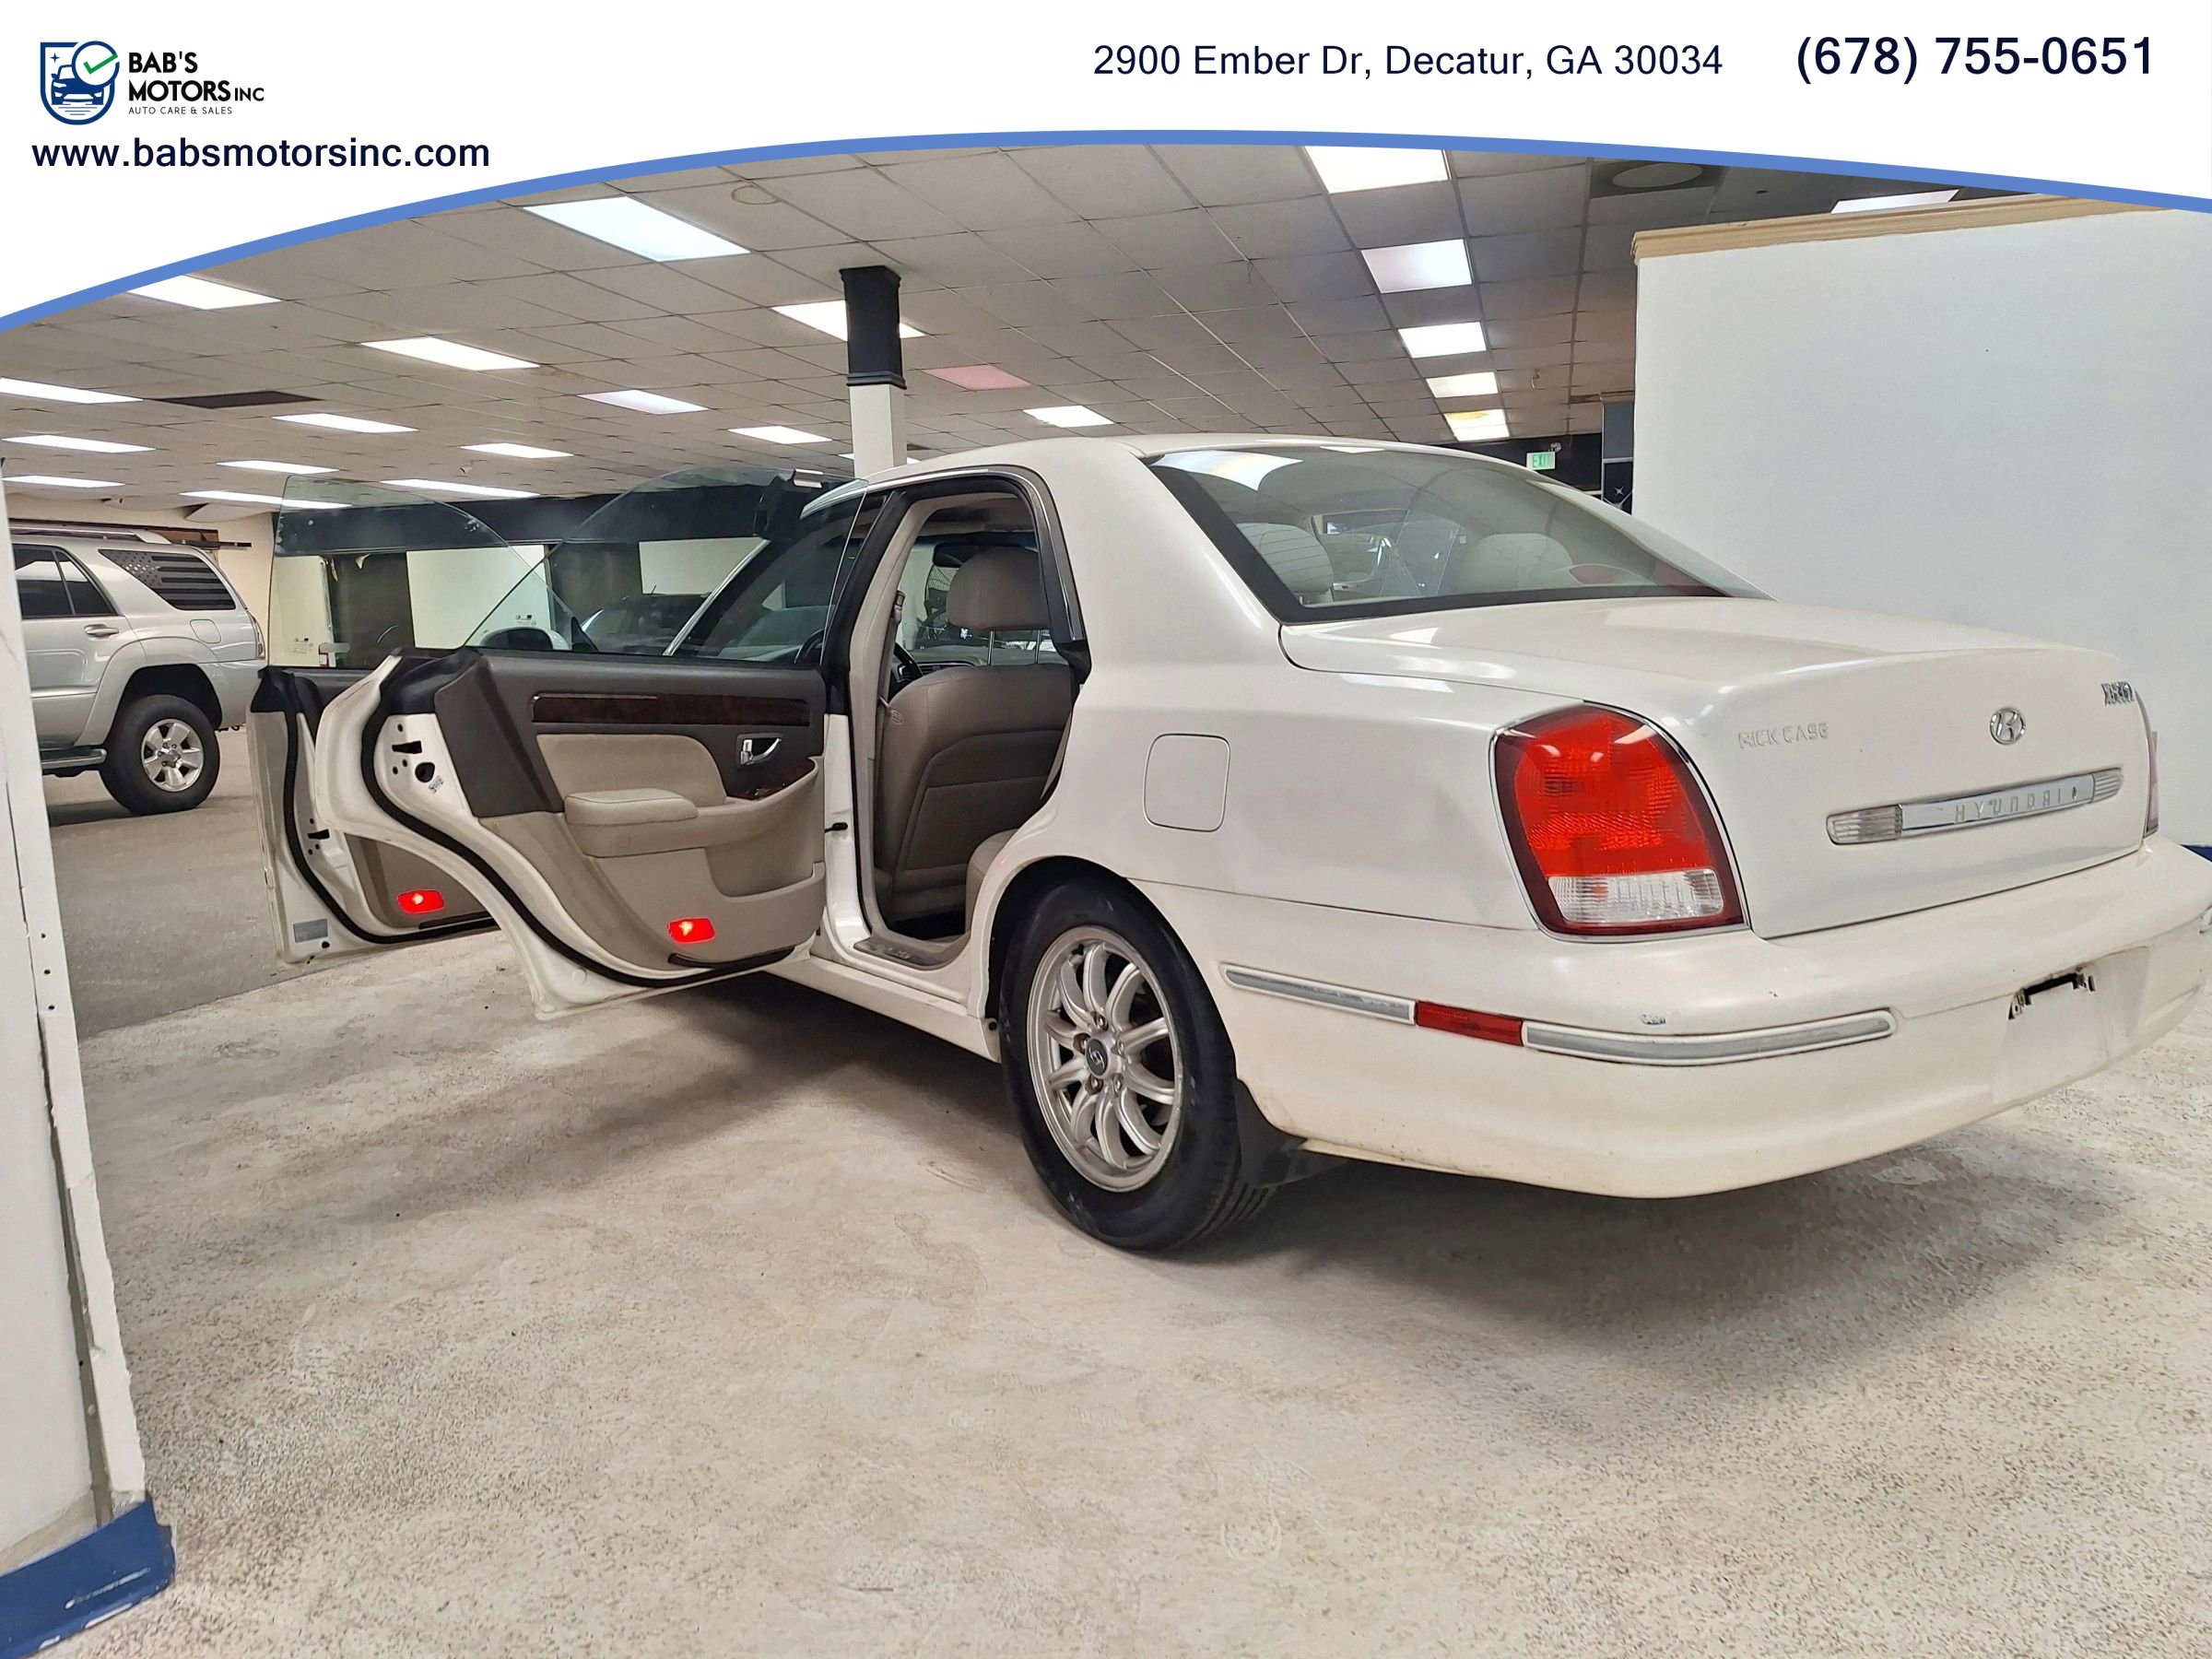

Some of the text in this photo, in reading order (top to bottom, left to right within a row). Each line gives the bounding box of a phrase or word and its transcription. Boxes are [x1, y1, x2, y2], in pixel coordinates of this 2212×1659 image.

[1532, 453, 1553, 468] EXIT
[1783, 723, 1829, 743] CASE
[1955, 788, 2061, 823] HYUNDAI
